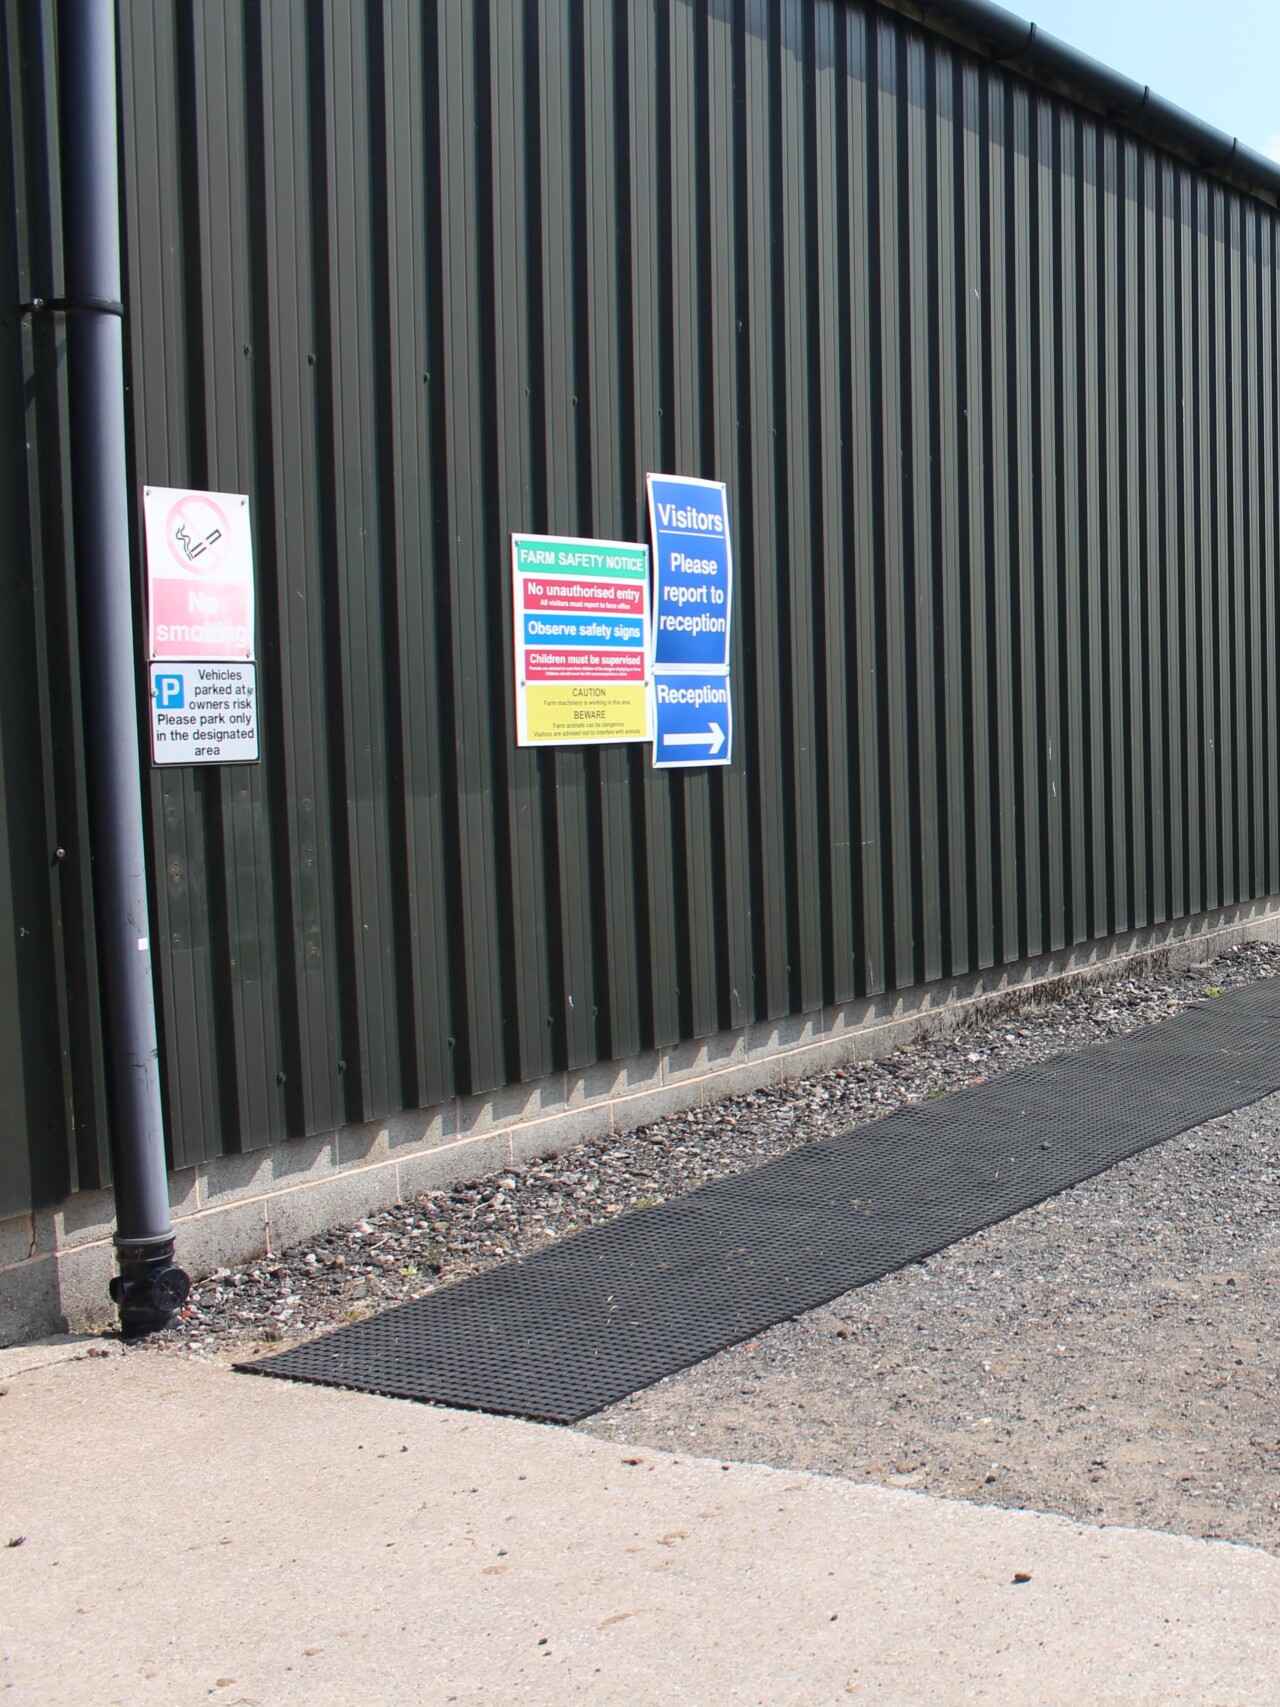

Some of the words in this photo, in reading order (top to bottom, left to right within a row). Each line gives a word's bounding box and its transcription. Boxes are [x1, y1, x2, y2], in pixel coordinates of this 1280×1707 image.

[657, 503, 723, 532] Visitors
[519, 549, 555, 565] FARM
[558, 551, 604, 568] SAFETY
[606, 555, 644, 572] NOTICE
[670, 552, 718, 575] Please
[188, 591, 219, 614] No
[527, 582, 543, 595] No
[546, 584, 614, 599] unauthorised
[616, 588, 640, 603] entry
[663, 585, 707, 607] report
[710, 585, 724, 604] to
[549, 599, 569, 607] visitors
[617, 602, 631, 610] office
[156, 620, 249, 648] smoking
[528, 620, 577, 635] Observe
[579, 623, 612, 640] safety
[613, 624, 641, 641] signs
[660, 613, 726, 637] reception
[529, 653, 566, 664] Children
[568, 654, 588, 665] must
[590, 654, 600, 664] be
[601, 655, 641, 666] supervised
[198, 669, 243, 681] Vehicles
[161, 678, 180, 706] P
[194, 684, 232, 697] parked
[235, 684, 246, 695] at
[572, 688, 606, 697] CAUTION
[657, 684, 727, 708] Reception
[189, 700, 230, 710] owners
[233, 698, 252, 709] risk
[157, 713, 197, 725] Please
[200, 713, 225, 727] park
[229, 712, 252, 726] only
[573, 710, 606, 720] BEWARE
[156, 730, 167, 741] in
[170, 729, 189, 741] the
[192, 728, 255, 742] designated
[194, 746, 221, 756] area
